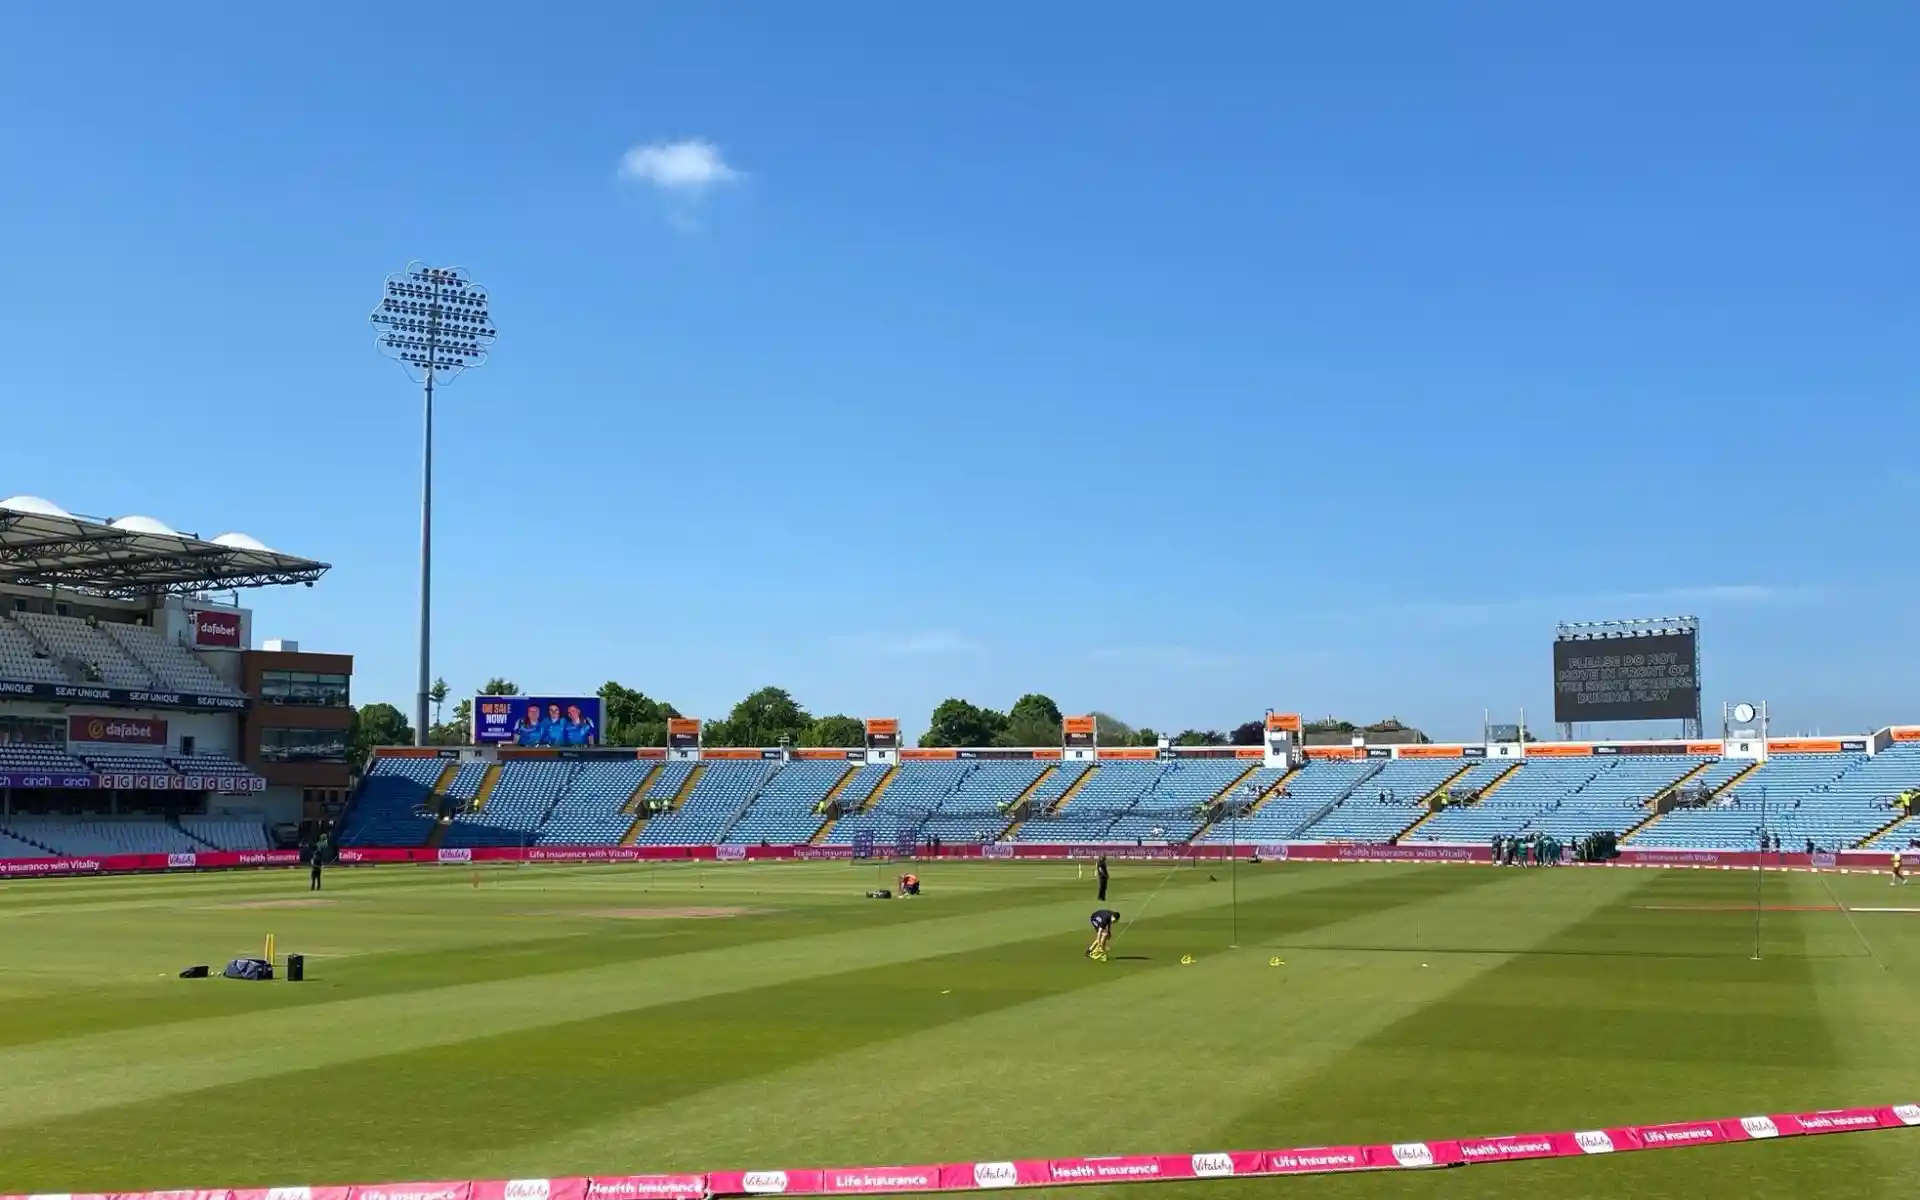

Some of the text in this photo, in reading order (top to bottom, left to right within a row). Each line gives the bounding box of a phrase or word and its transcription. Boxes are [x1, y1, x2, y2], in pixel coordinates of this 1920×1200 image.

[201, 624, 235, 636] dafabet
[1568, 653, 1678, 669] PLEASE DO NOT
[1559, 664, 1690, 681] MOVE IN FRONT OF
[0, 683, 34, 693] UNIQUE
[1585, 679, 1625, 692] SIGHT
[1628, 676, 1692, 690] SCREENS
[55, 686, 110, 699] SEAT UNIQUE
[130, 692, 180, 704] SEAT UNIQUE
[1577, 690, 1670, 704] DURING PLAY
[198, 697, 244, 708] SEAT UNIQUE
[486, 714, 507, 724] NOW!
[106, 724, 151, 738] dafabet
[23, 776, 51, 786] cinch
[63, 777, 90, 787] cinch
[240, 854, 300, 863] Health insuranc
[338, 851, 362, 861] tality
[529, 850, 544, 859] Life
[588, 850, 606, 858] with
[608, 850, 639, 860] Vitality
[1339, 848, 1368, 857] Health
[1439, 848, 1473, 859] Vitality
[8, 863, 48, 871] insurance
[51, 861, 69, 870] with
[71, 860, 100, 871] Vitality
[1743, 1119, 1776, 1134] Vitality
[1800, 1114, 1877, 1129] Health insurance
[1578, 1133, 1612, 1149] Vitality
[1644, 1128, 1713, 1143] Life insurance
[1394, 1146, 1432, 1161] Vitality
[1460, 1141, 1552, 1156] Health insurance
[1194, 1156, 1233, 1173] Vitality
[1272, 1153, 1355, 1168] Life insurance
[975, 1166, 1016, 1181] Vitality
[1052, 1163, 1159, 1178] Health insurance
[591, 1180, 635, 1194] Health
[745, 1175, 785, 1188] Vitality
[836, 1175, 861, 1187] Life
